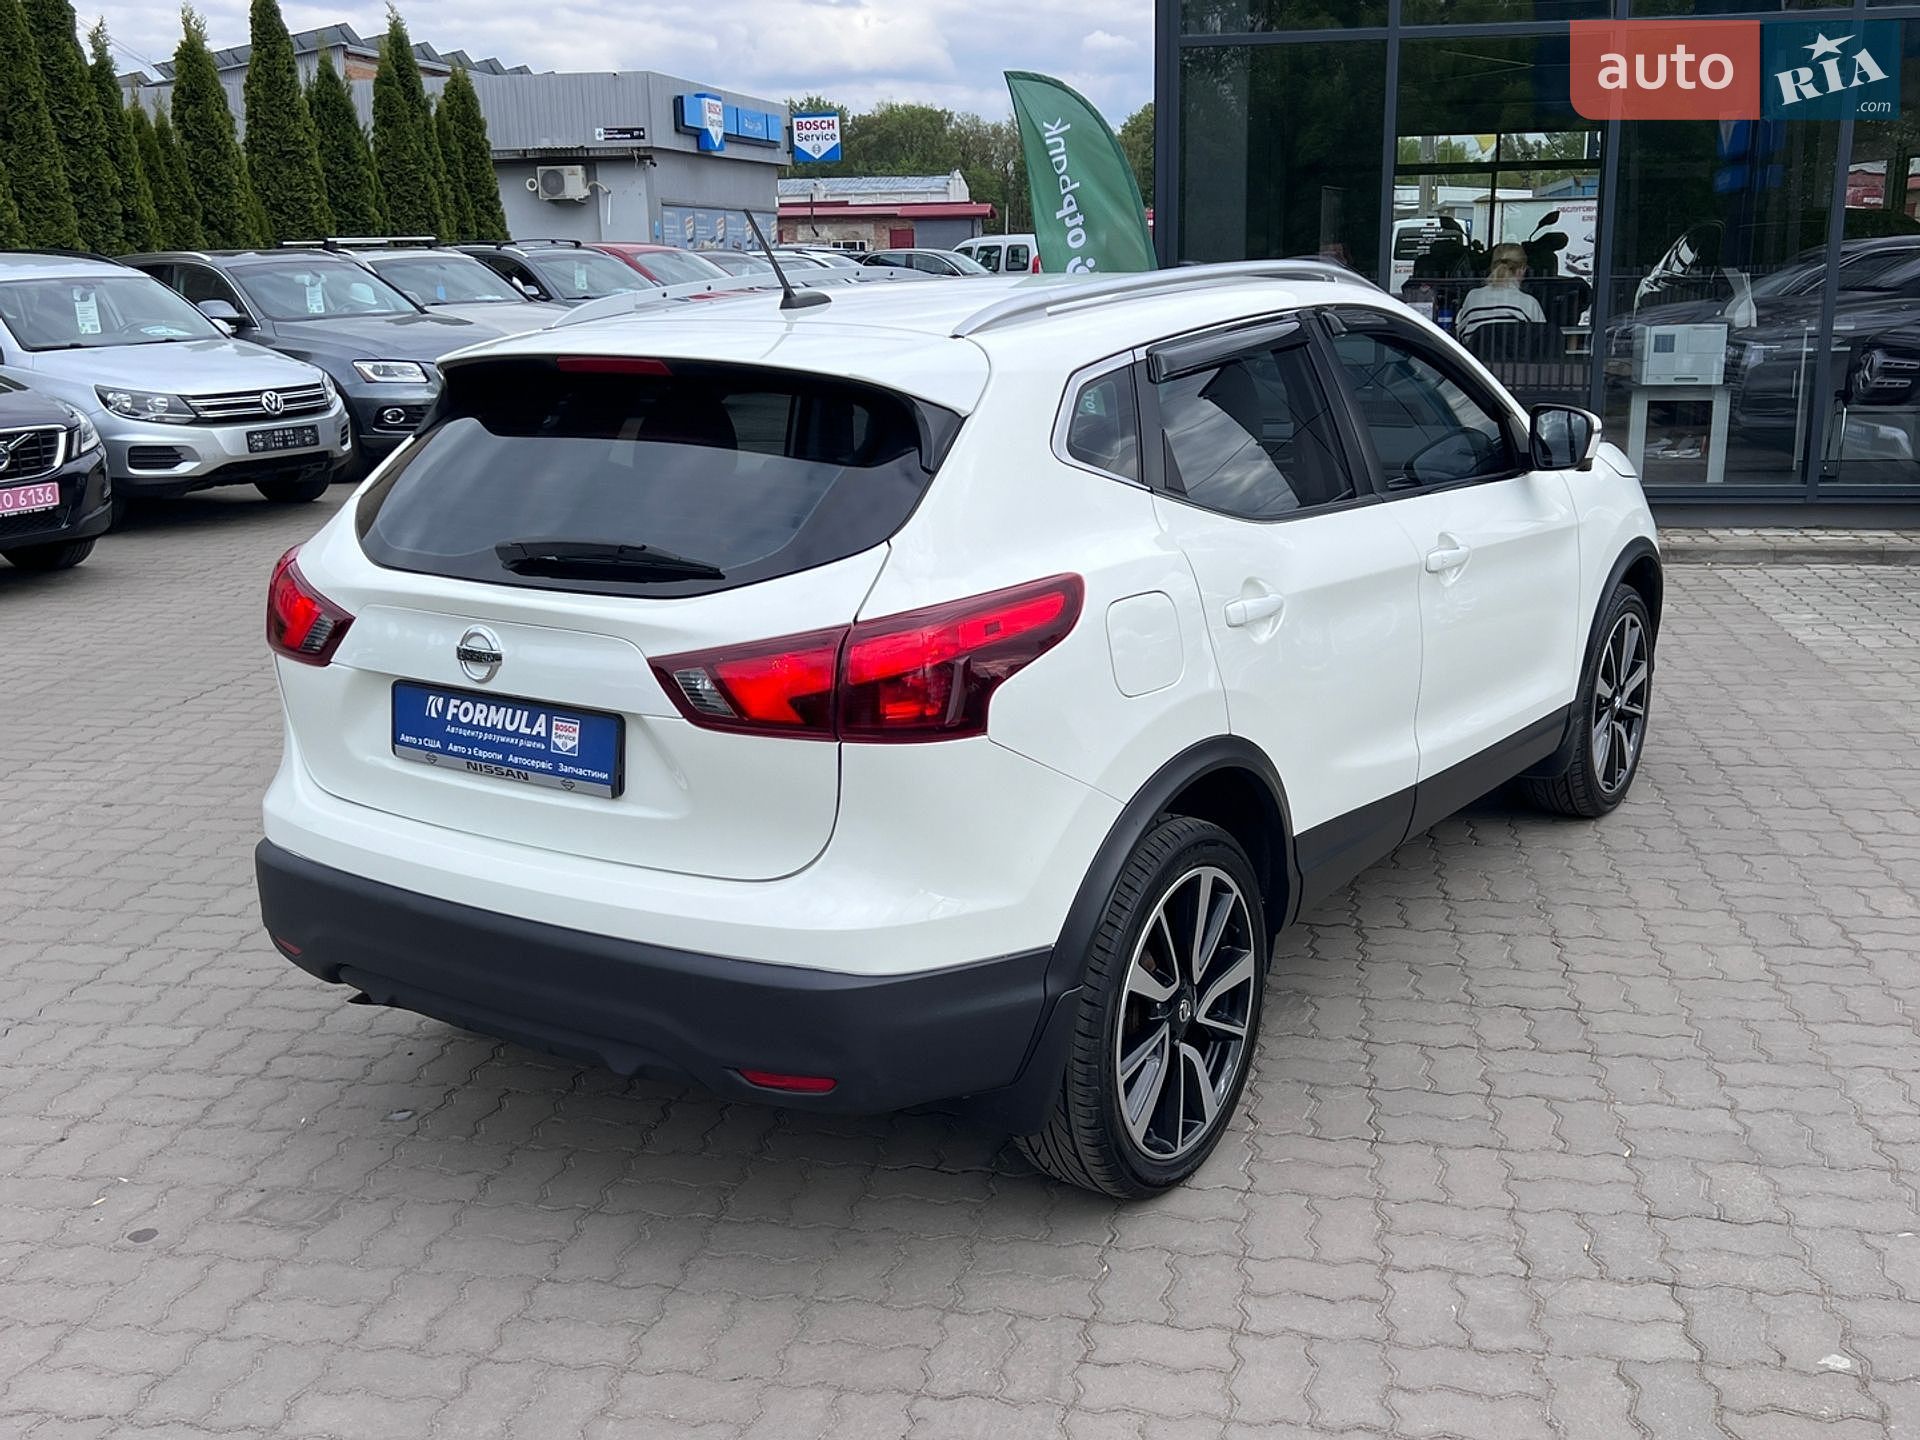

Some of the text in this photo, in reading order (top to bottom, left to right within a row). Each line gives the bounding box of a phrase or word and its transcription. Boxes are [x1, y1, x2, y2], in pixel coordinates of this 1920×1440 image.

[707, 102, 721, 115] BOSCH
[796, 120, 835, 131] BOSCH
[797, 132, 837, 142] Service
[18, 486, 54, 506] 6136
[446, 699, 547, 737] FORMULA
[555, 723, 577, 734] BOSCH
[445, 724, 483, 740] Автоцентр
[518, 737, 546, 750] рішень
[554, 732, 576, 742] Service
[400, 733, 417, 744] Авто
[423, 737, 442, 749] США
[447, 742, 466, 754] Авто
[473, 747, 502, 760] Європи
[508, 754, 553, 770] Автосервіс
[558, 762, 609, 780] Запчастини
[465, 761, 529, 781] NISSAN
